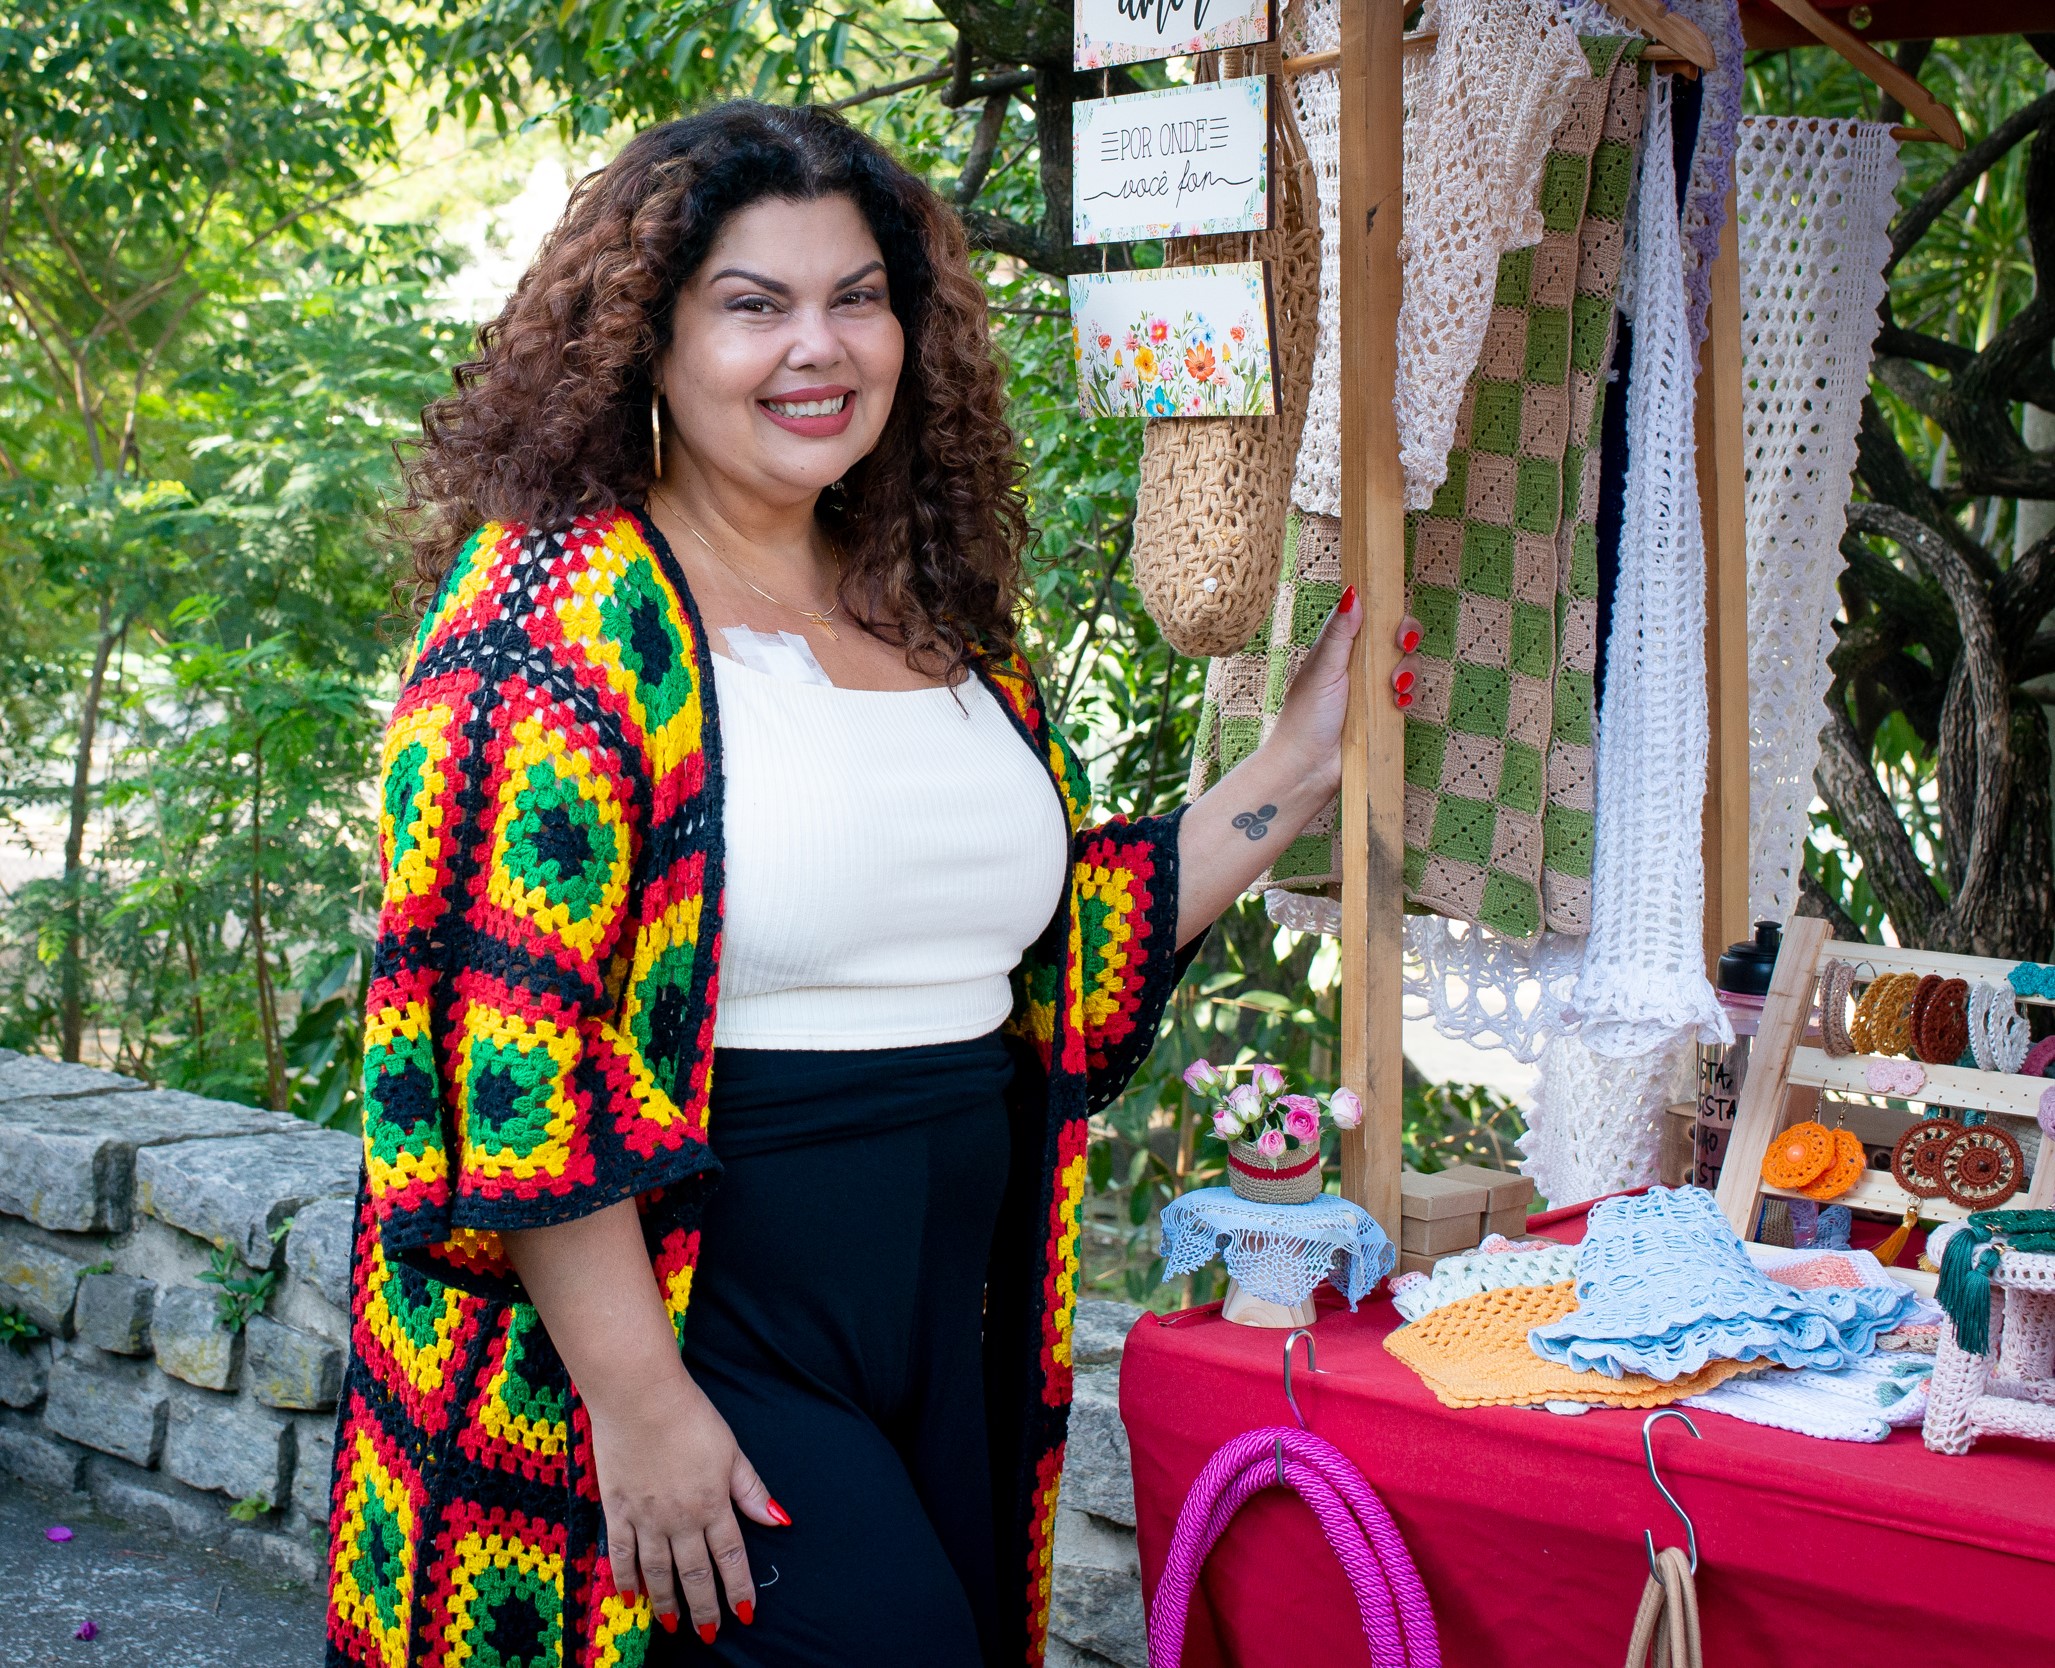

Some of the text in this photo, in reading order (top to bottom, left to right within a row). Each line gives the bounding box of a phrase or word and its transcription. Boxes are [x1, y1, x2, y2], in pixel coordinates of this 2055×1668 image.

[1120, 118, 1208, 160] POR ONDE
[1100, 170, 1169, 200] você
